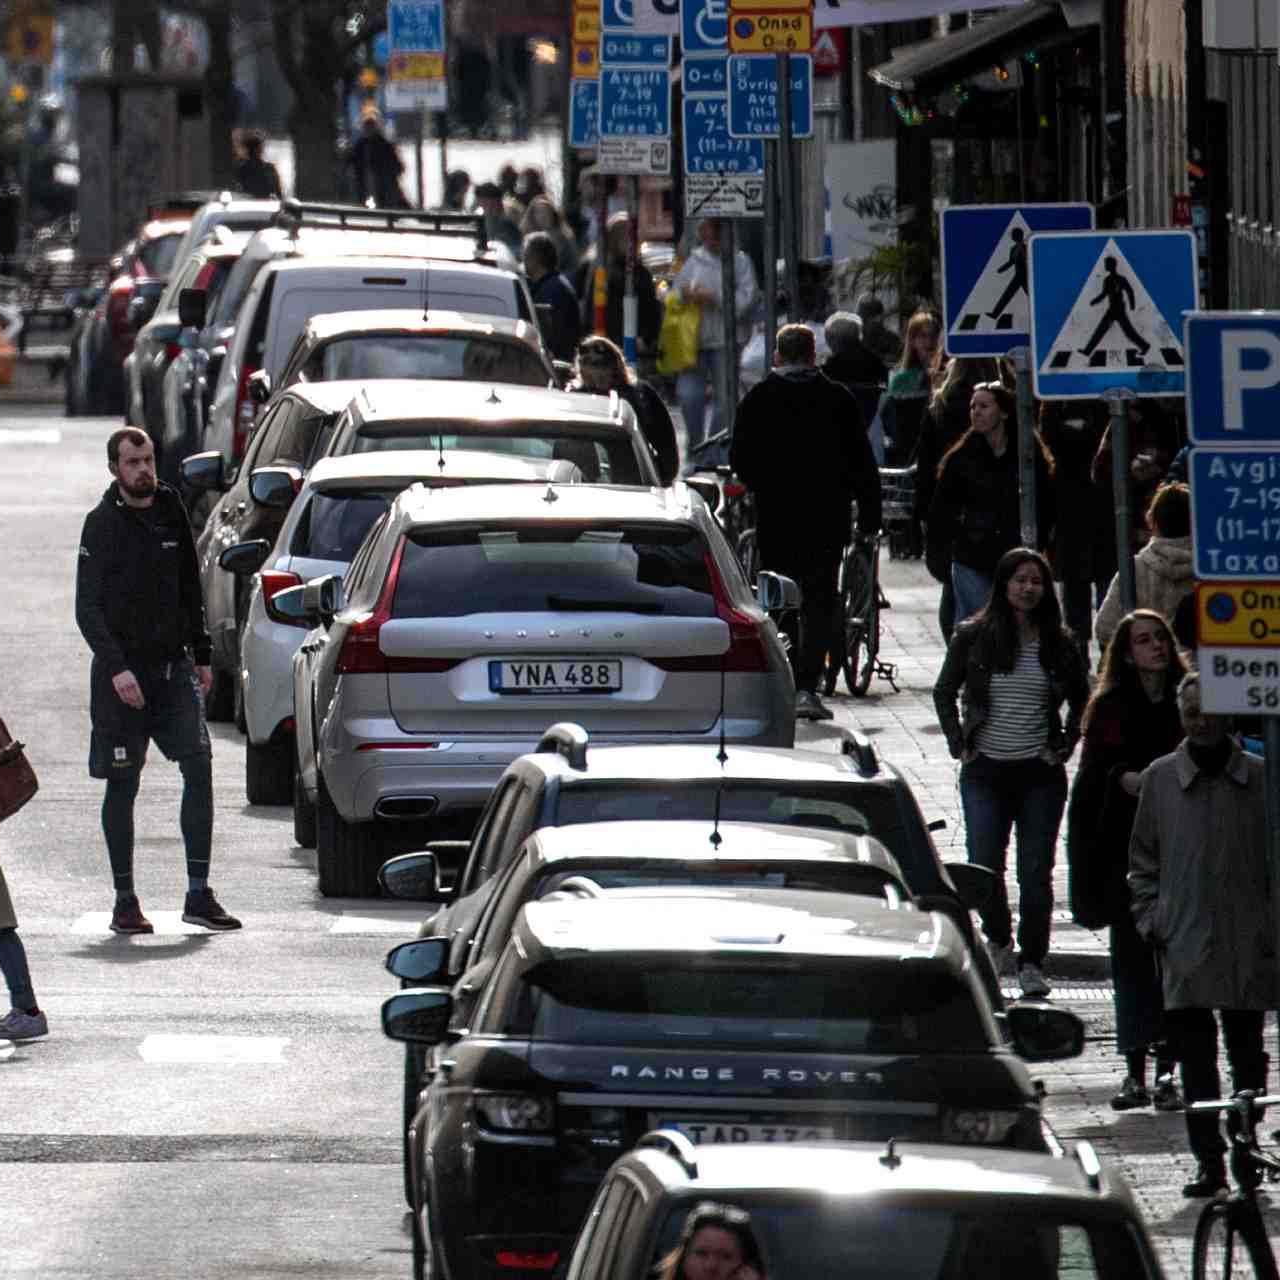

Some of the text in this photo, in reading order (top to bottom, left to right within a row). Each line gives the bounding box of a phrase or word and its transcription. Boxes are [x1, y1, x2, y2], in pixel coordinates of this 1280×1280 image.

[758, 15, 801, 31] Onsd
[692, 156, 739, 170] Taxa
[1221, 330, 1280, 431] P
[510, 664, 610, 686] YNA 488
[611, 1065, 885, 1084] RANGE ROVER
